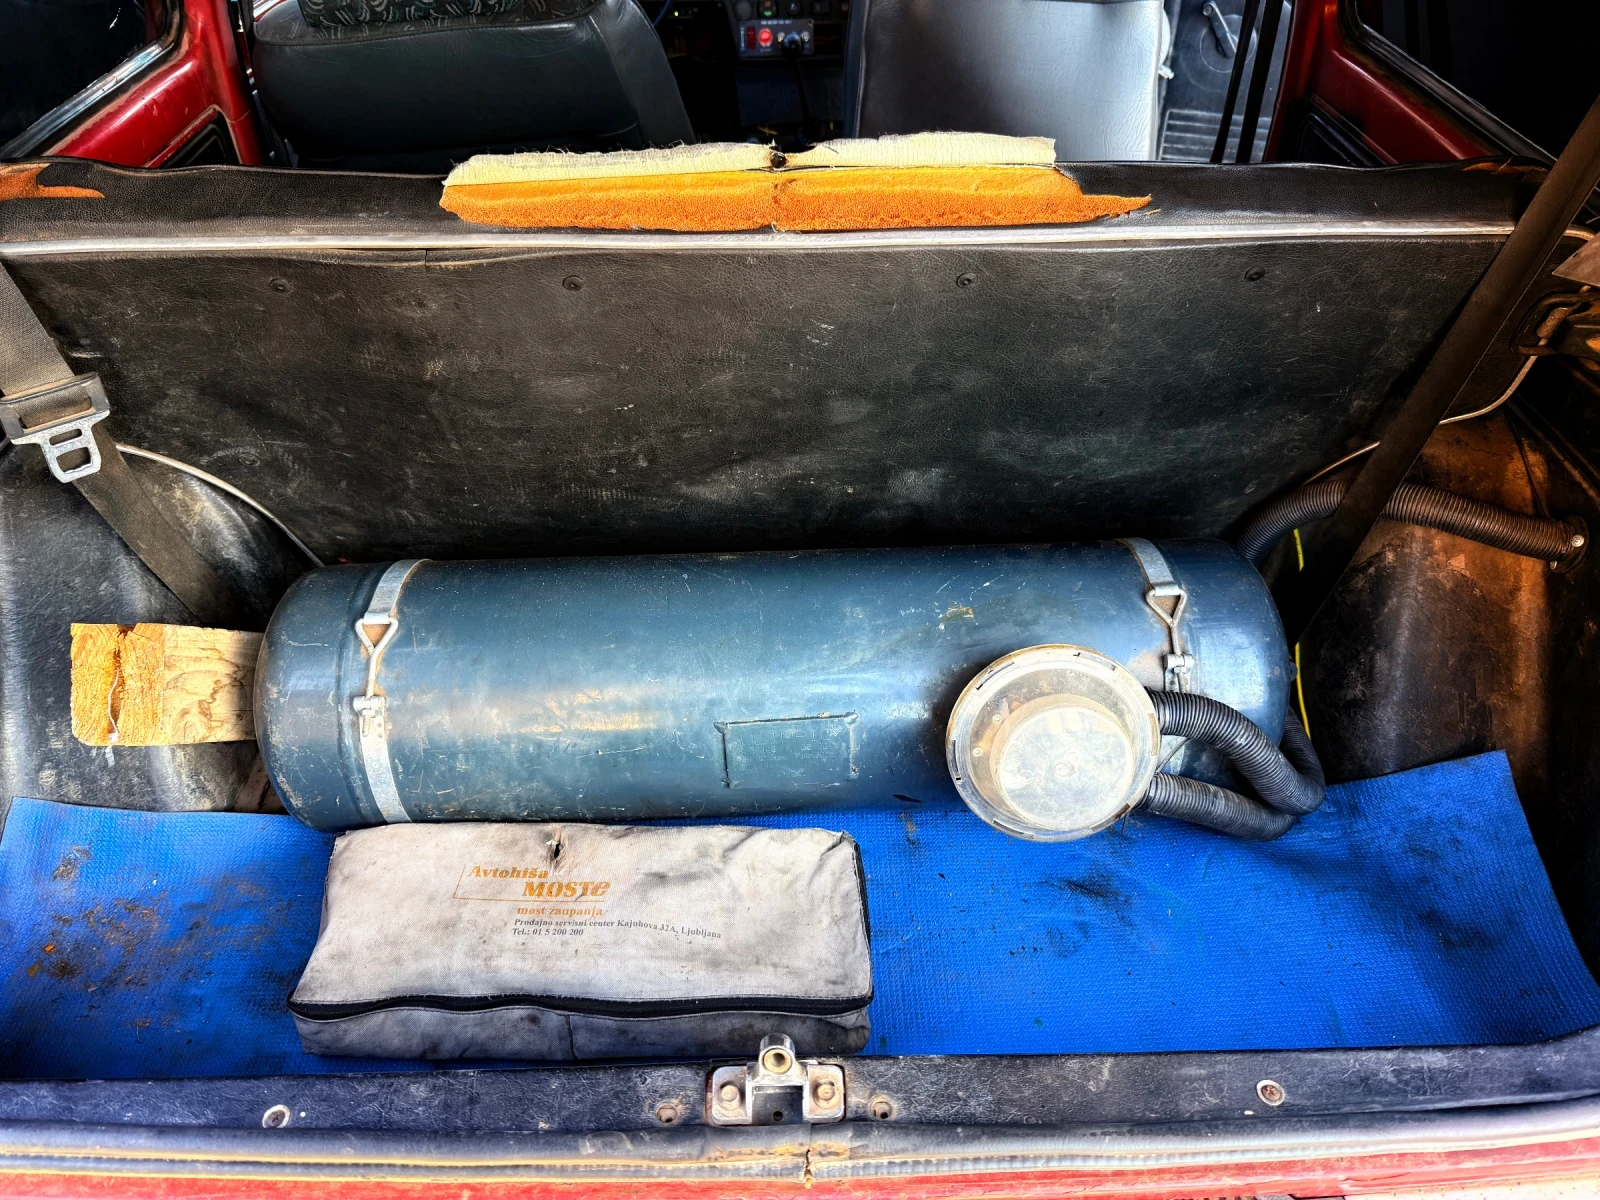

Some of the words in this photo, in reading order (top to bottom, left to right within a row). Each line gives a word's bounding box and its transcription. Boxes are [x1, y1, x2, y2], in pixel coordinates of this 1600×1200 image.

[468, 865, 549, 879] Avtohiša
[517, 907, 547, 915] most
[549, 906, 604, 918] zaupanja
[512, 928, 530, 936] Tel.:
[532, 928, 541, 936] 01
[544, 928, 550, 936] 5
[552, 928, 567, 936] 200
[569, 928, 584, 936] 200
[514, 918, 553, 927] Prodajno
[555, 919, 587, 927] servisni
[617, 919, 658, 929] Kajuhova
[659, 923, 679, 934] 32A,
[681, 926, 722, 939] Ljubljana
